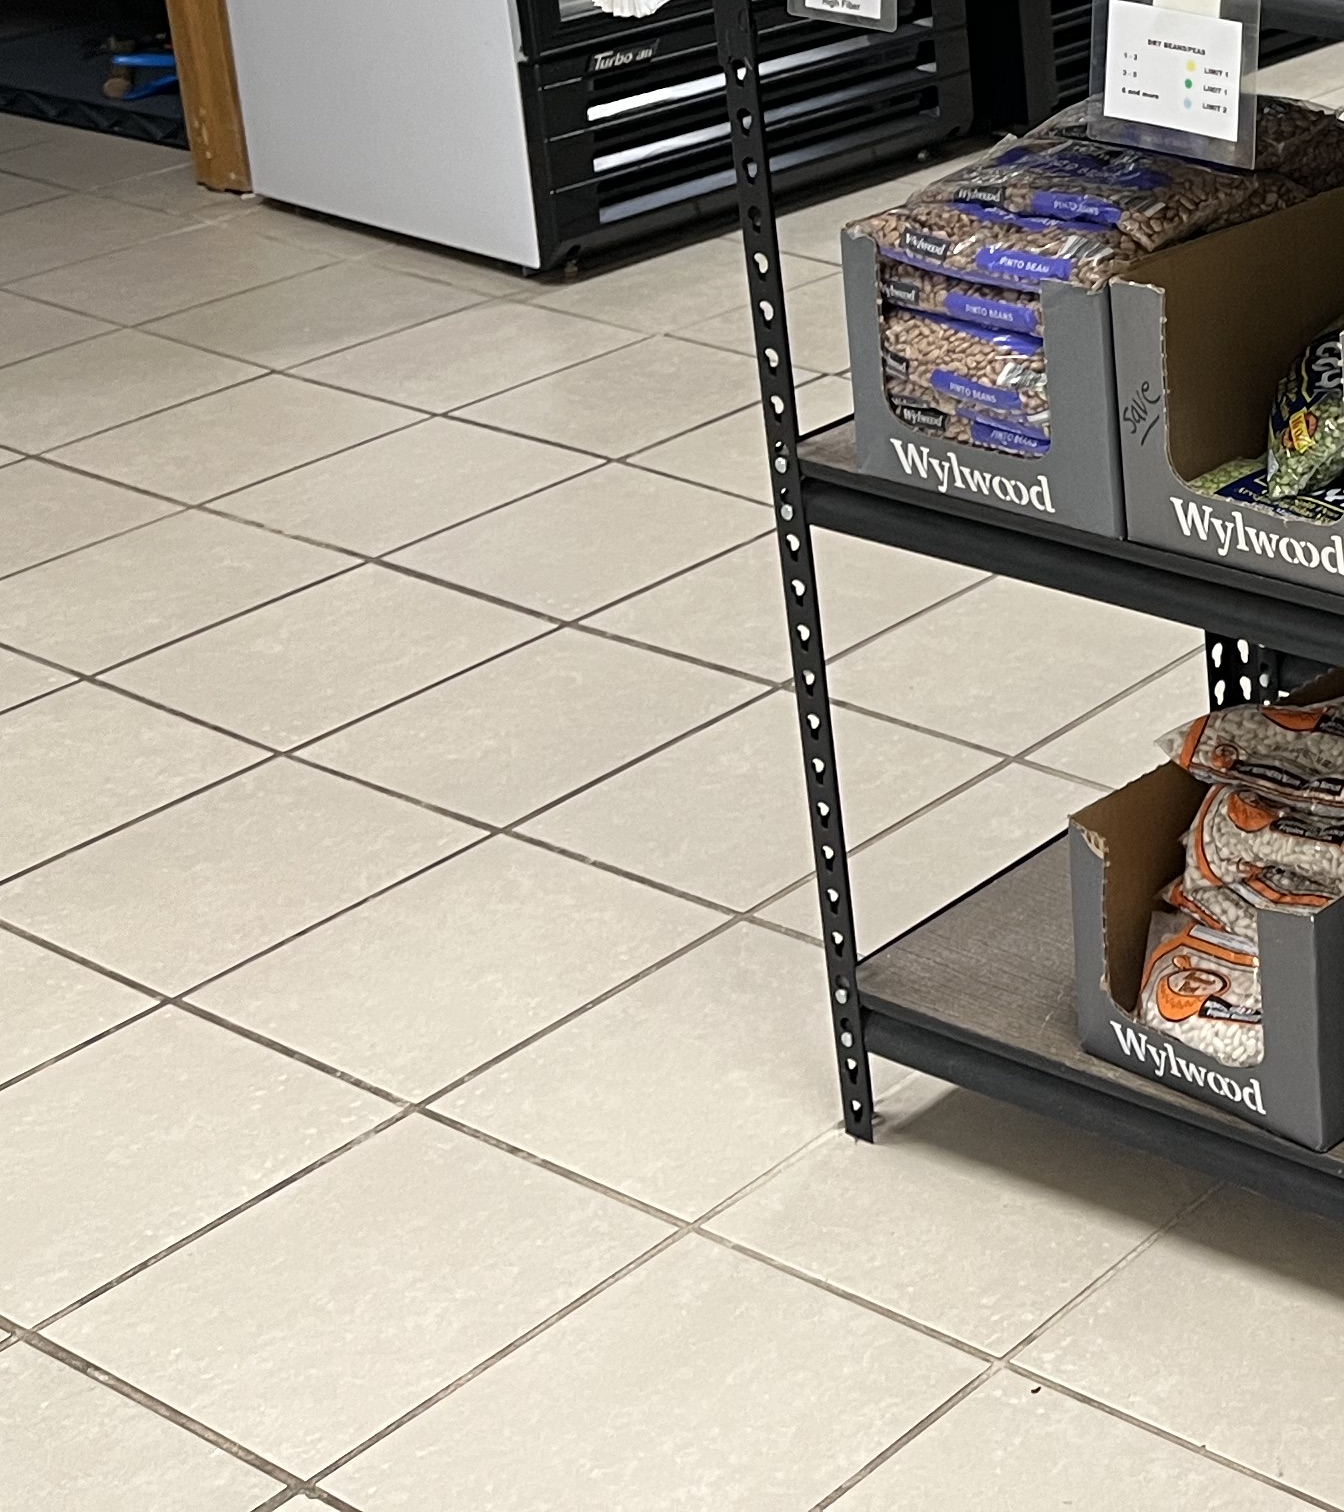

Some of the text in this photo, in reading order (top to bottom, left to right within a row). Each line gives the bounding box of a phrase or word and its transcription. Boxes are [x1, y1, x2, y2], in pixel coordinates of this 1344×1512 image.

[841, 0, 860, 10] Fiber
[1147, 39, 1162, 47] DRY
[1204, 67, 1223, 77] LIMIT
[1203, 85, 1222, 94] LIMIT
[1202, 102, 1221, 112] LIMIT
[965, 303, 987, 317] PINTO
[988, 308, 1014, 322] BEANS
[950, 382, 997, 403] PINTO BEANS
[903, 407, 944, 426] Wylwood
[889, 437, 1056, 515] Wylwood
[1110, 1020, 1267, 1116] Wylwood
